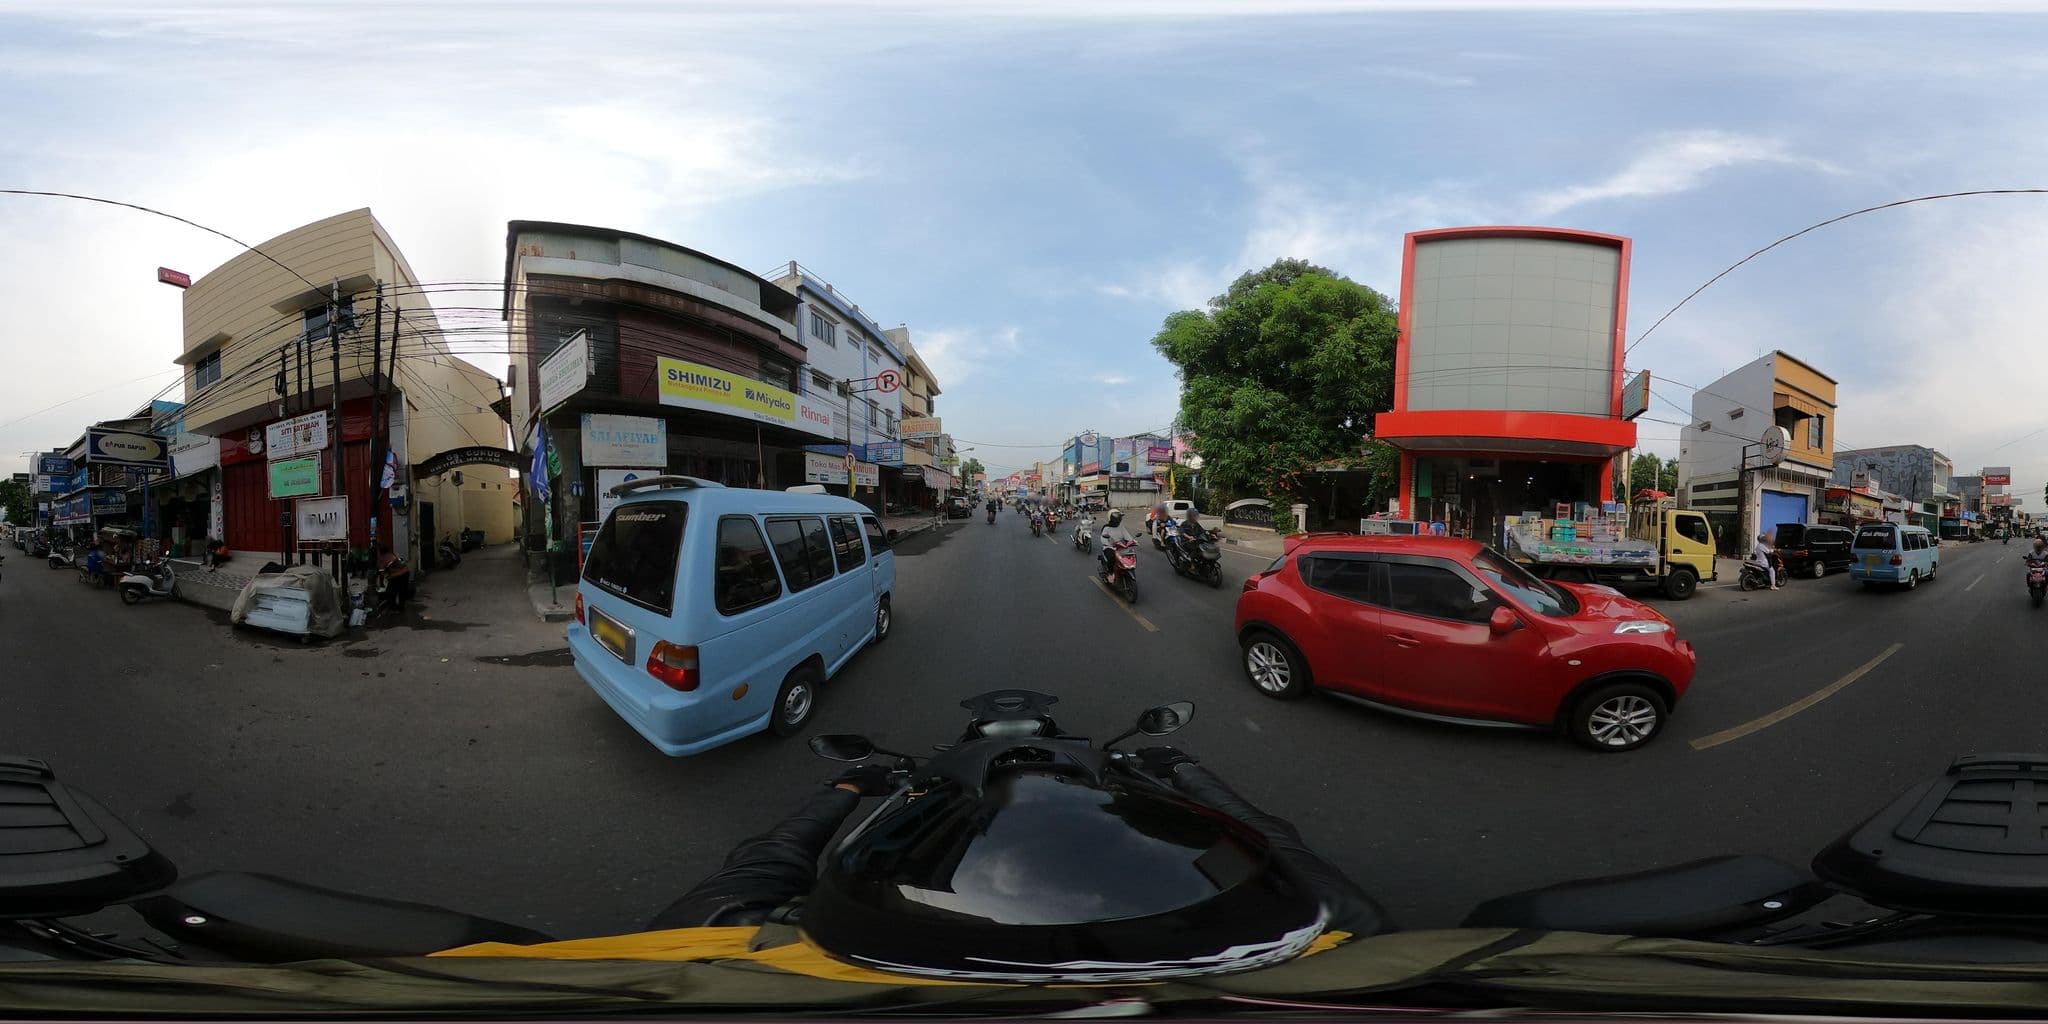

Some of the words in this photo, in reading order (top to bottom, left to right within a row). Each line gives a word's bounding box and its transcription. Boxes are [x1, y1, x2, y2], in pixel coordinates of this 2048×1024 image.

[667, 368, 732, 392] SHIMIZU
[756, 391, 791, 411] Miyako
[800, 404, 830, 425] Rinnai
[281, 427, 292, 436] SITI
[810, 459, 828, 469] Toko
[828, 462, 841, 470] Mas
